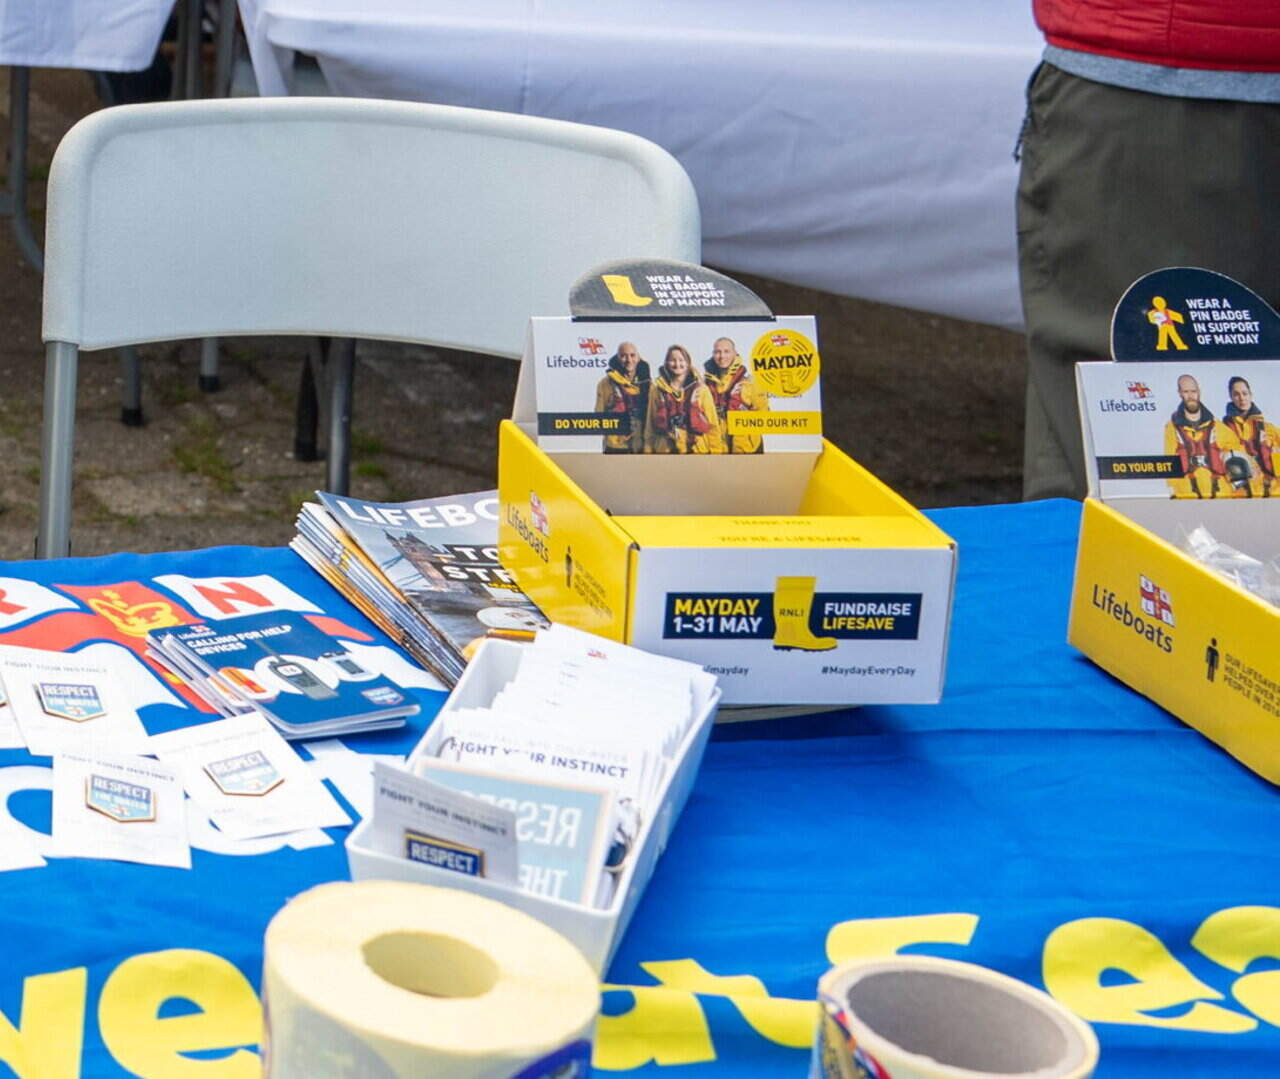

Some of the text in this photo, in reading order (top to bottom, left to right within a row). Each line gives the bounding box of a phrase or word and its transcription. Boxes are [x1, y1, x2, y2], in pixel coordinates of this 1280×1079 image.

[646, 274, 694, 284] WEAR A
[651, 282, 716, 291] PIN BADGE
[669, 290, 726, 298] SUPPORT
[658, 298, 726, 307] OF MAYDAY
[1186, 298, 1231, 309] WEAR A
[1190, 310, 1251, 321] PIN BADGE
[1193, 321, 1260, 333] IN SUPPORT
[1197, 334, 1259, 345] OF MAYDAY
[546, 354, 609, 369] Lifeboats
[752, 353, 814, 372] MAYDAY
[1100, 399, 1157, 412] Lifeboats
[555, 418, 619, 430] DO YOUR BIT
[735, 418, 808, 428] FUND OUR KIT
[1113, 462, 1172, 473] DO YOUR BIT
[506, 503, 549, 563] Lifeboats
[193, 580, 274, 614] N
[674, 598, 912, 617] MAYDAY FUNDRAISE
[779, 608, 805, 617] RNLI
[1092, 583, 1174, 653] Lifeboats
[720, 617, 763, 633] MAY
[823, 617, 895, 631] LIFESAVE
[187, 624, 292, 649] CALLING FOR HELP
[197, 642, 247, 656] DEVICES
[821, 665, 916, 677] #MaydayEveryDay
[551, 754, 629, 779] INSTINCT
[380, 786, 415, 804] FIGHT
[418, 800, 449, 818] YOUR
[409, 841, 475, 873] RESPECT
